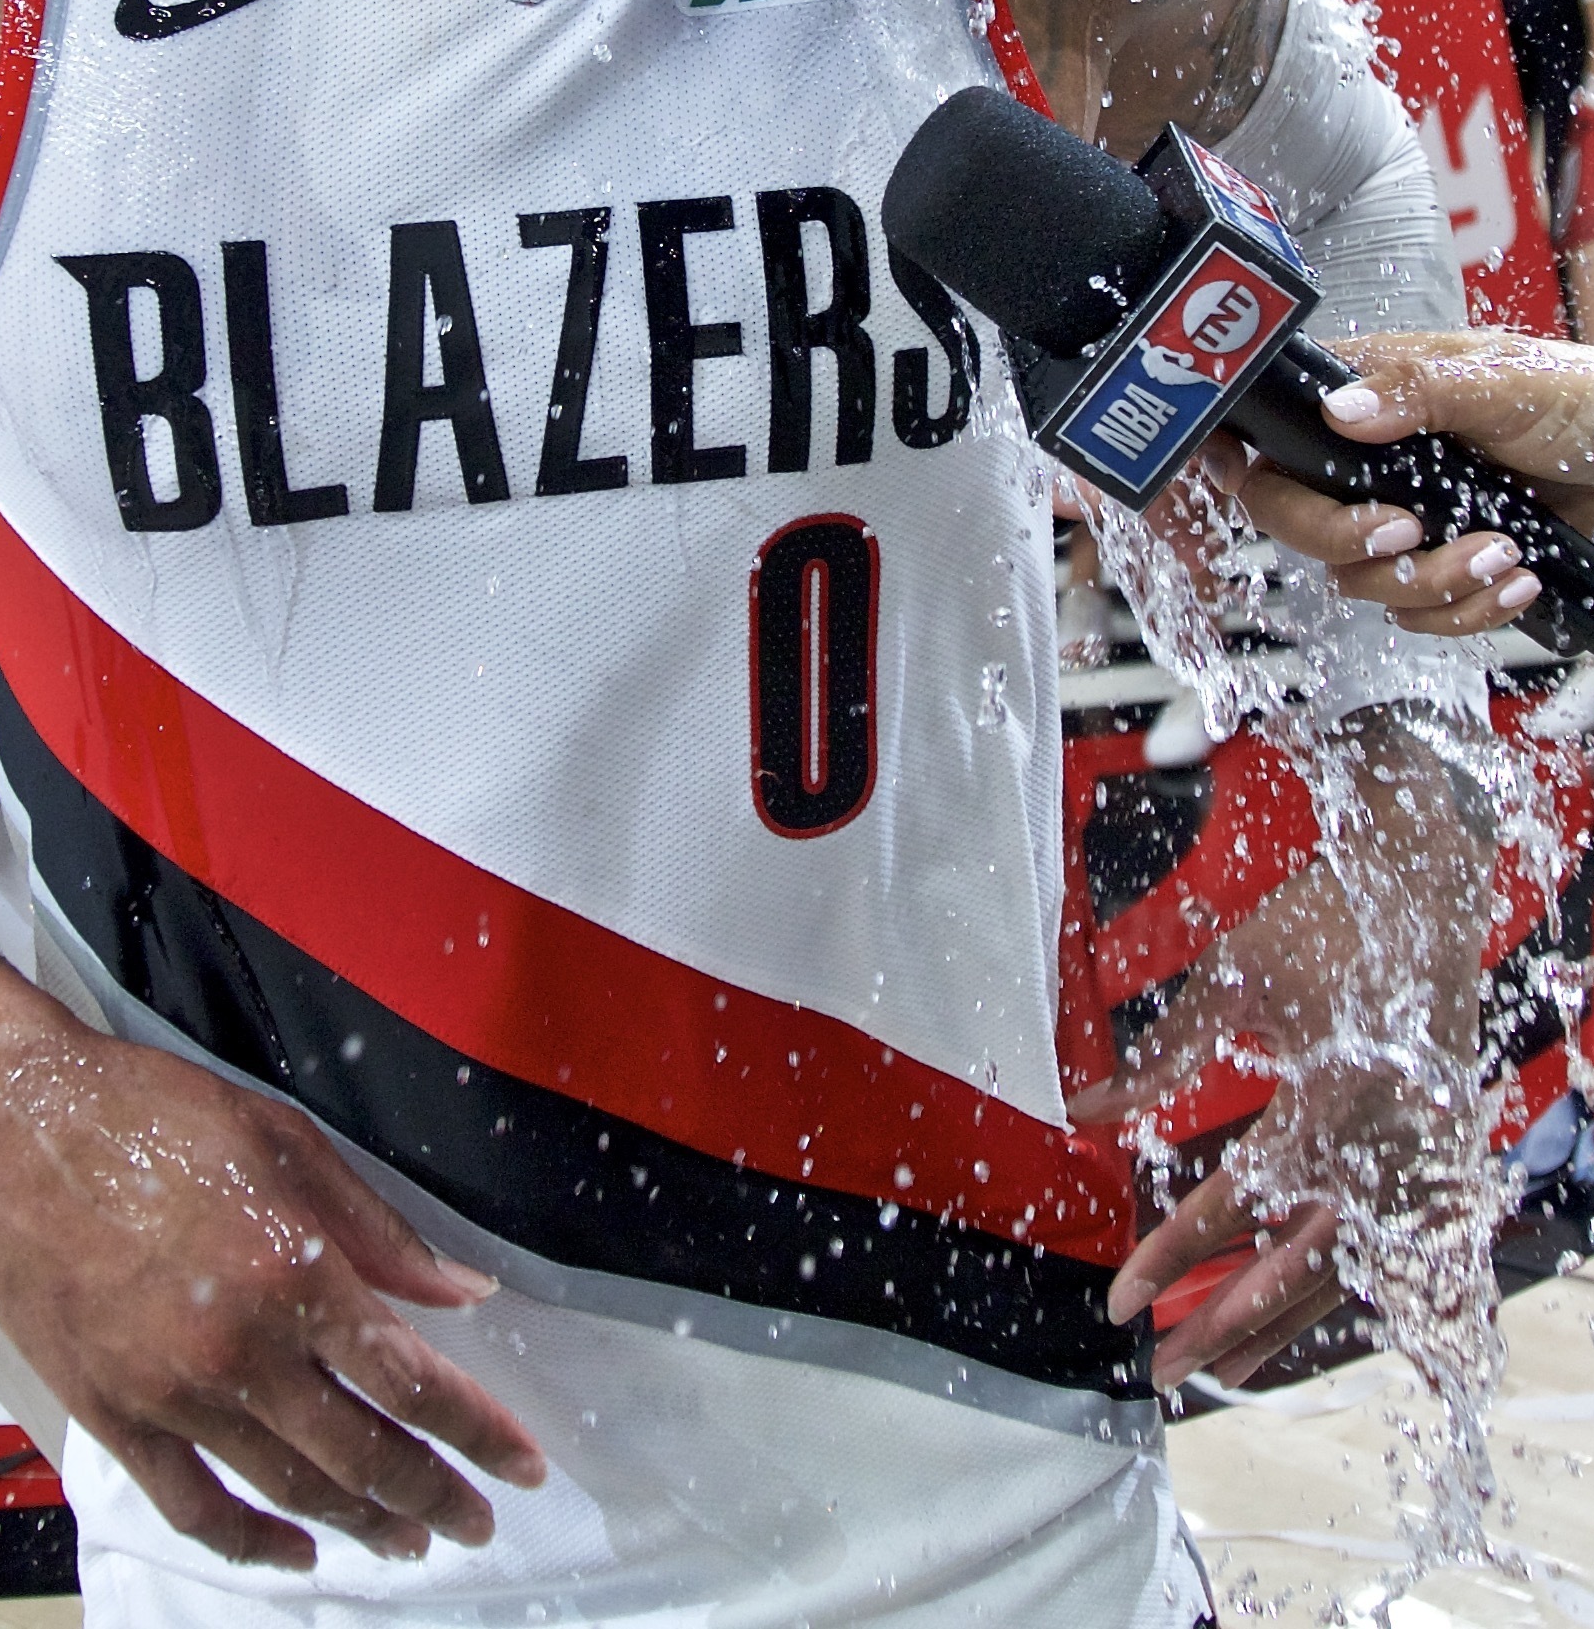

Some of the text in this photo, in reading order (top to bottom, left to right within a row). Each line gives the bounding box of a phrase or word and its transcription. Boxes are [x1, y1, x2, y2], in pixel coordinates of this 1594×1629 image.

[53, 185, 981, 532] BLAZERS
[1090, 381, 1179, 461] NBA
[1191, 280, 1253, 349] TNT
[750, 512, 881, 840] 0
